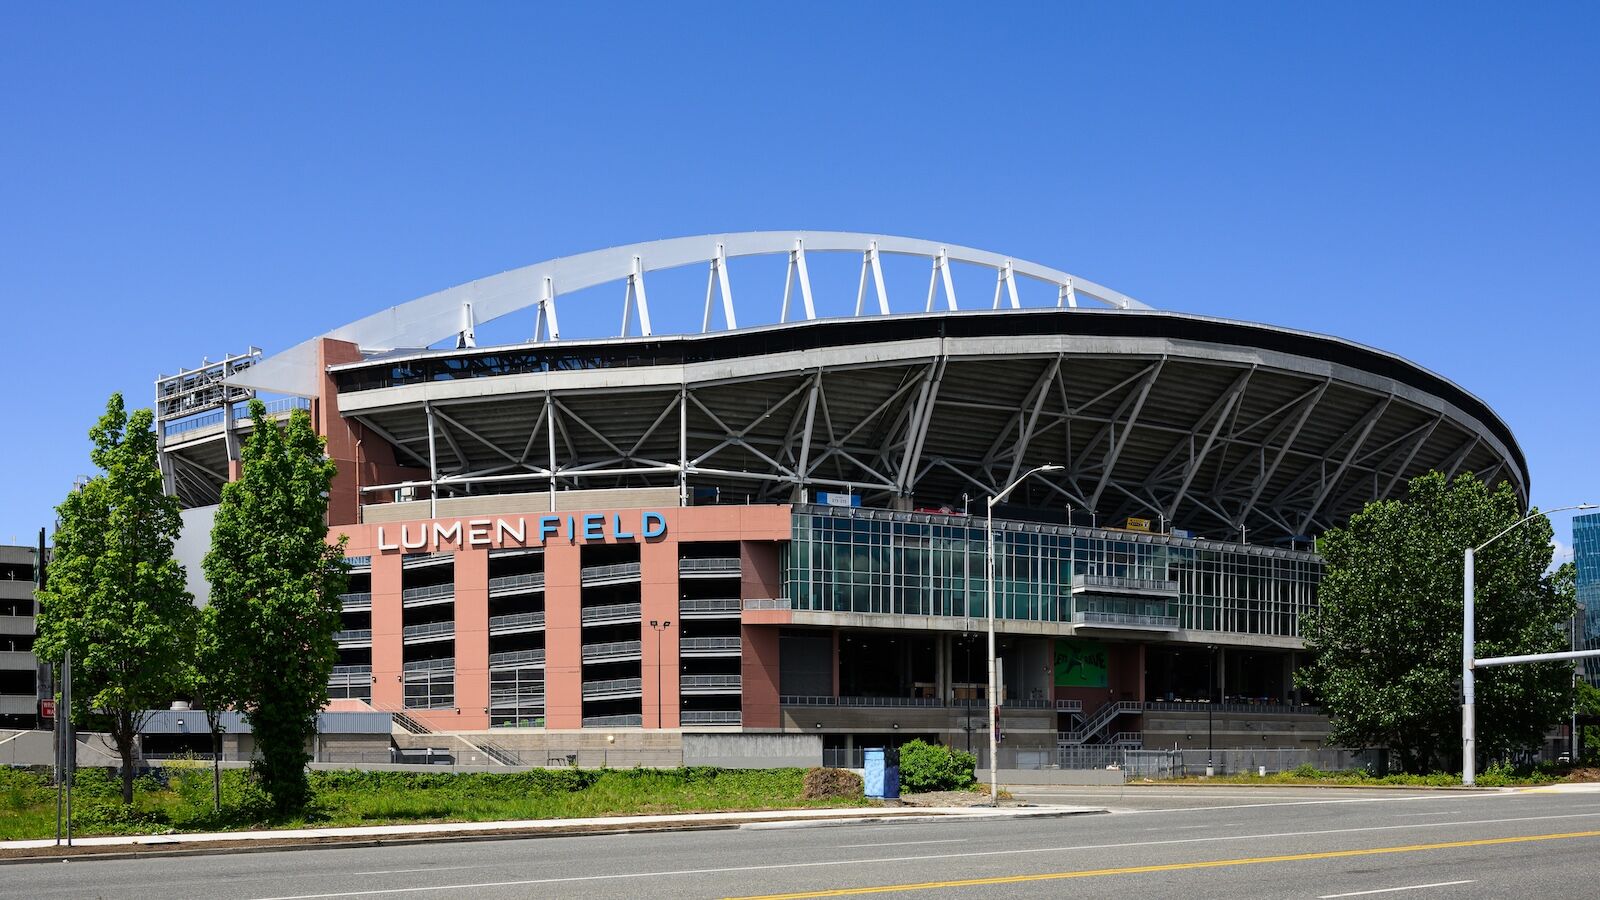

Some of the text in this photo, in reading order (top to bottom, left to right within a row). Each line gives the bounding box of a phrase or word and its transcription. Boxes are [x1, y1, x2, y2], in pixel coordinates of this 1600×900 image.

[378, 512, 666, 550] LUMEN FIELD
[340, 556, 371, 565] AINIE
